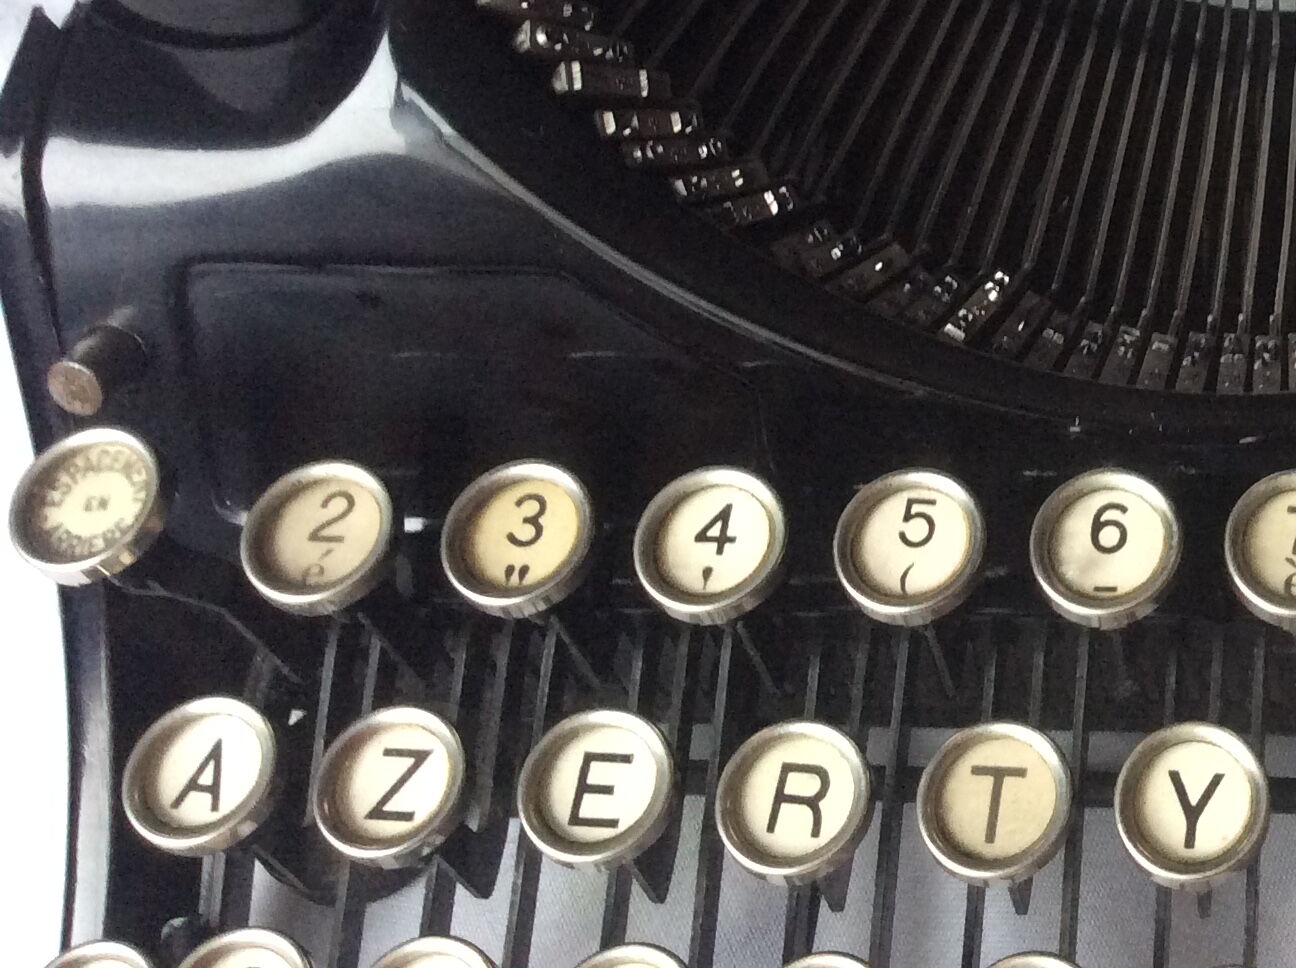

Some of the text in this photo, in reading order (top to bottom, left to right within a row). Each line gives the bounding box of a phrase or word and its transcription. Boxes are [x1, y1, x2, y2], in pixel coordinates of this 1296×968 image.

[307, 489, 356, 544] 2
[506, 492, 545, 548] 3
[694, 503, 737, 556] 4
[898, 497, 937, 548] 5
[1090, 502, 1129, 555] 6
[170, 738, 224, 813] A
[364, 748, 433, 823] Z
[567, 752, 634, 829] E
[766, 762, 830, 839] R
[970, 765, 1029, 845] T
[1167, 769, 1225, 851] Y
